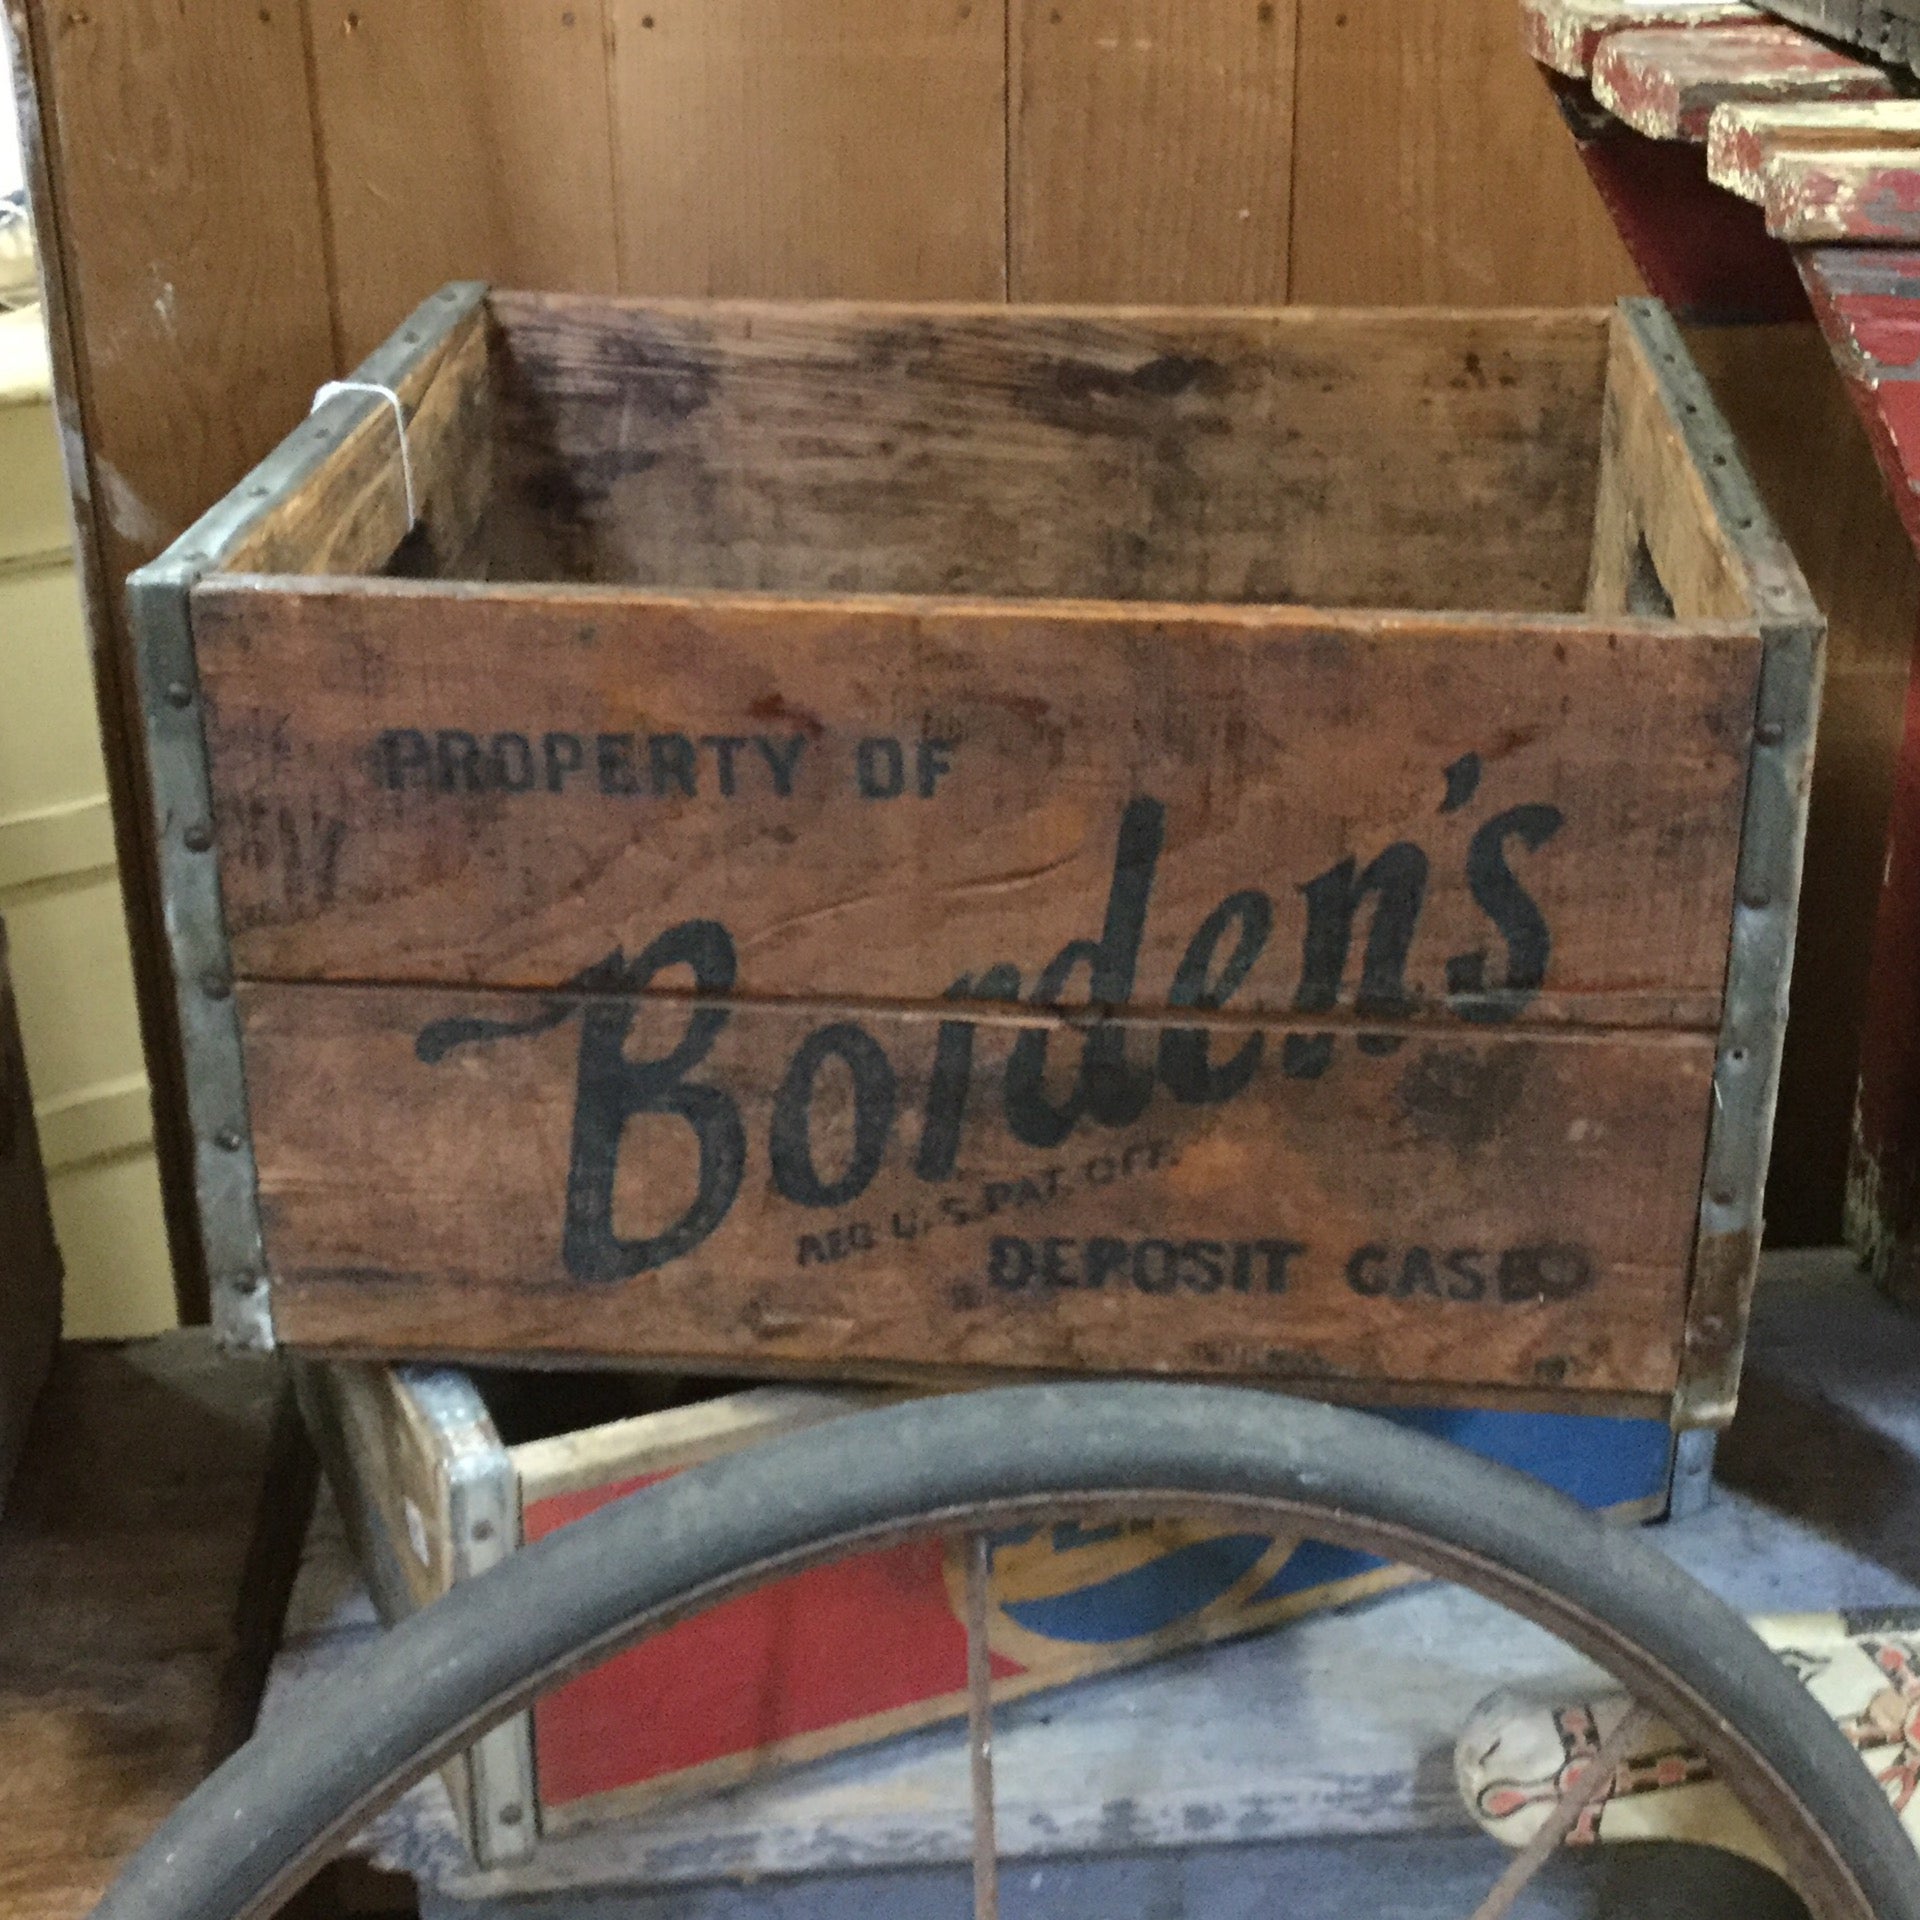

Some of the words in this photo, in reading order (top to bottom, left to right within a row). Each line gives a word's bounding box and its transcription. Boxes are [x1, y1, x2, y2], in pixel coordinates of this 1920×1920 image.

[376, 727, 803, 799] PROPERTY
[857, 736, 957, 799] OF
[415, 752, 1563, 1282] Borden's
[990, 1235, 1305, 1295] DEPOSIT
